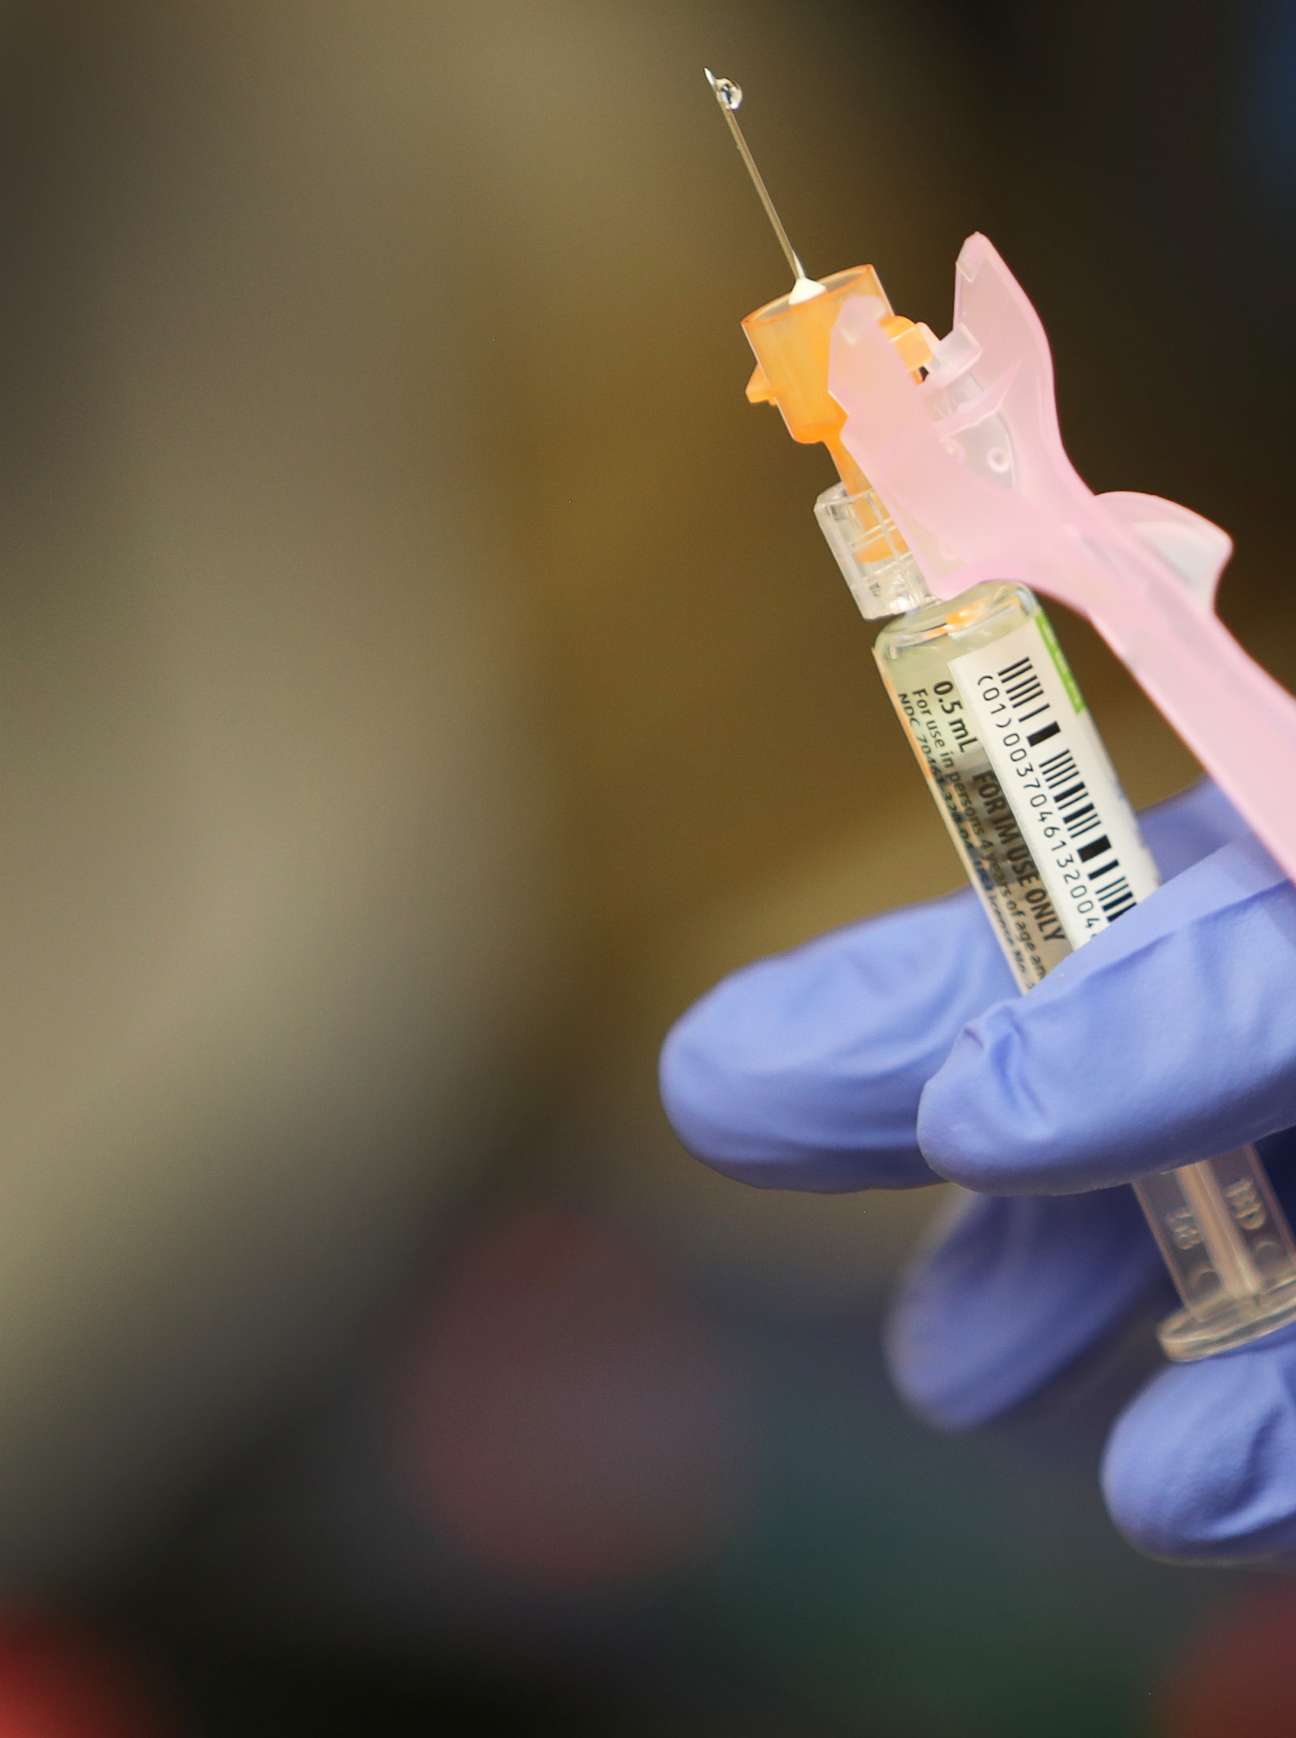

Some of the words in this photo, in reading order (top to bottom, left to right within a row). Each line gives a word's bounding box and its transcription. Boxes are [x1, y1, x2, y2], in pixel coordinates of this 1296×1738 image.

[898, 692, 920, 728] NDC
[913, 688, 932, 717] For
[934, 680, 961, 714] 0.5
[926, 720, 945, 748] use
[950, 718, 978, 753] mL
[940, 752, 957, 769] in
[944, 772, 985, 836] persons
[974, 771, 1006, 814] FOR
[977, 675, 1099, 938] (01)0037046132004
[978, 837, 992, 850] 4
[992, 813, 1021, 844] IM
[1006, 845, 1040, 887] USE
[1006, 898, 1023, 920] of
[1025, 888, 1065, 944] ONLY
[1011, 921, 1036, 954] age
[1029, 955, 1048, 980] an
